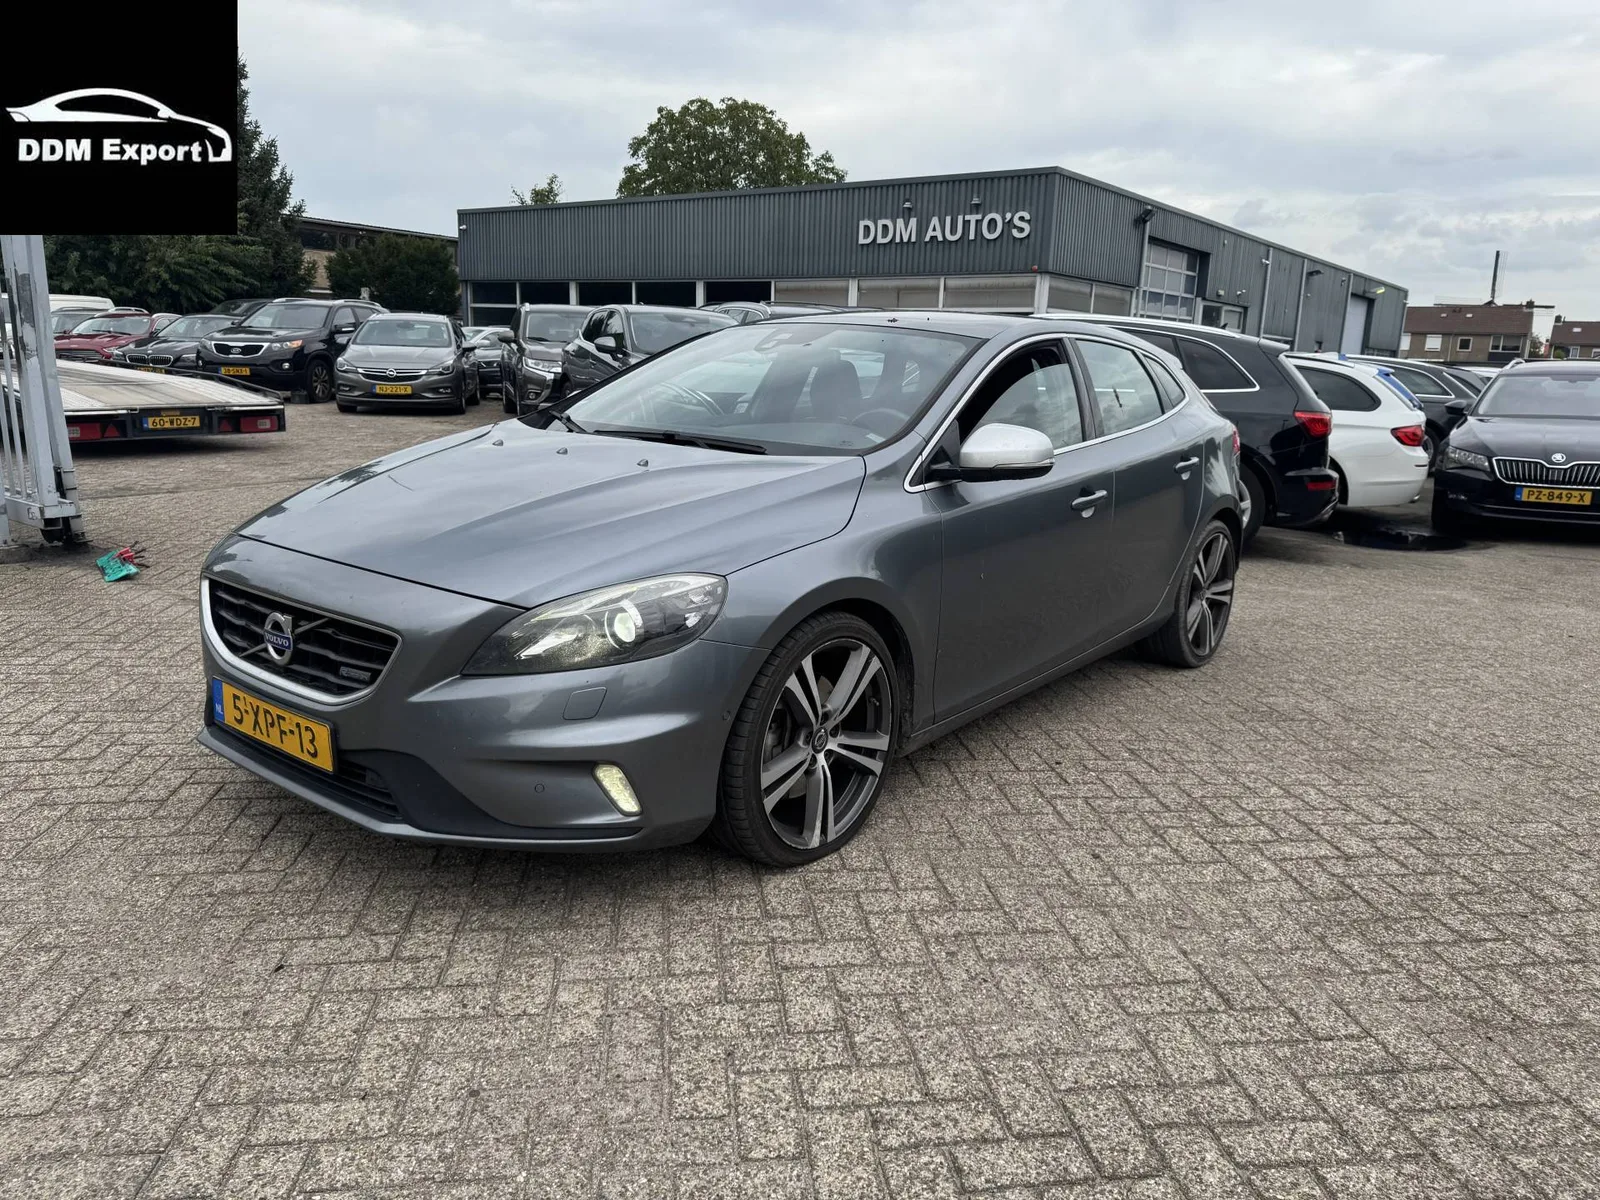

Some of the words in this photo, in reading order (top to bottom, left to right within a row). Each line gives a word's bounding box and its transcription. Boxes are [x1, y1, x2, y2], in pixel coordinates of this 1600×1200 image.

[858, 217, 917, 244] DDM
[924, 211, 1031, 242] AUTO'S
[151, 417, 197, 428] 60-WDZ-7
[1527, 489, 1587, 503] PZ-849-X
[265, 632, 289, 647] VOLVO
[215, 703, 224, 715] NL
[232, 692, 318, 758] 5-XPF-13
